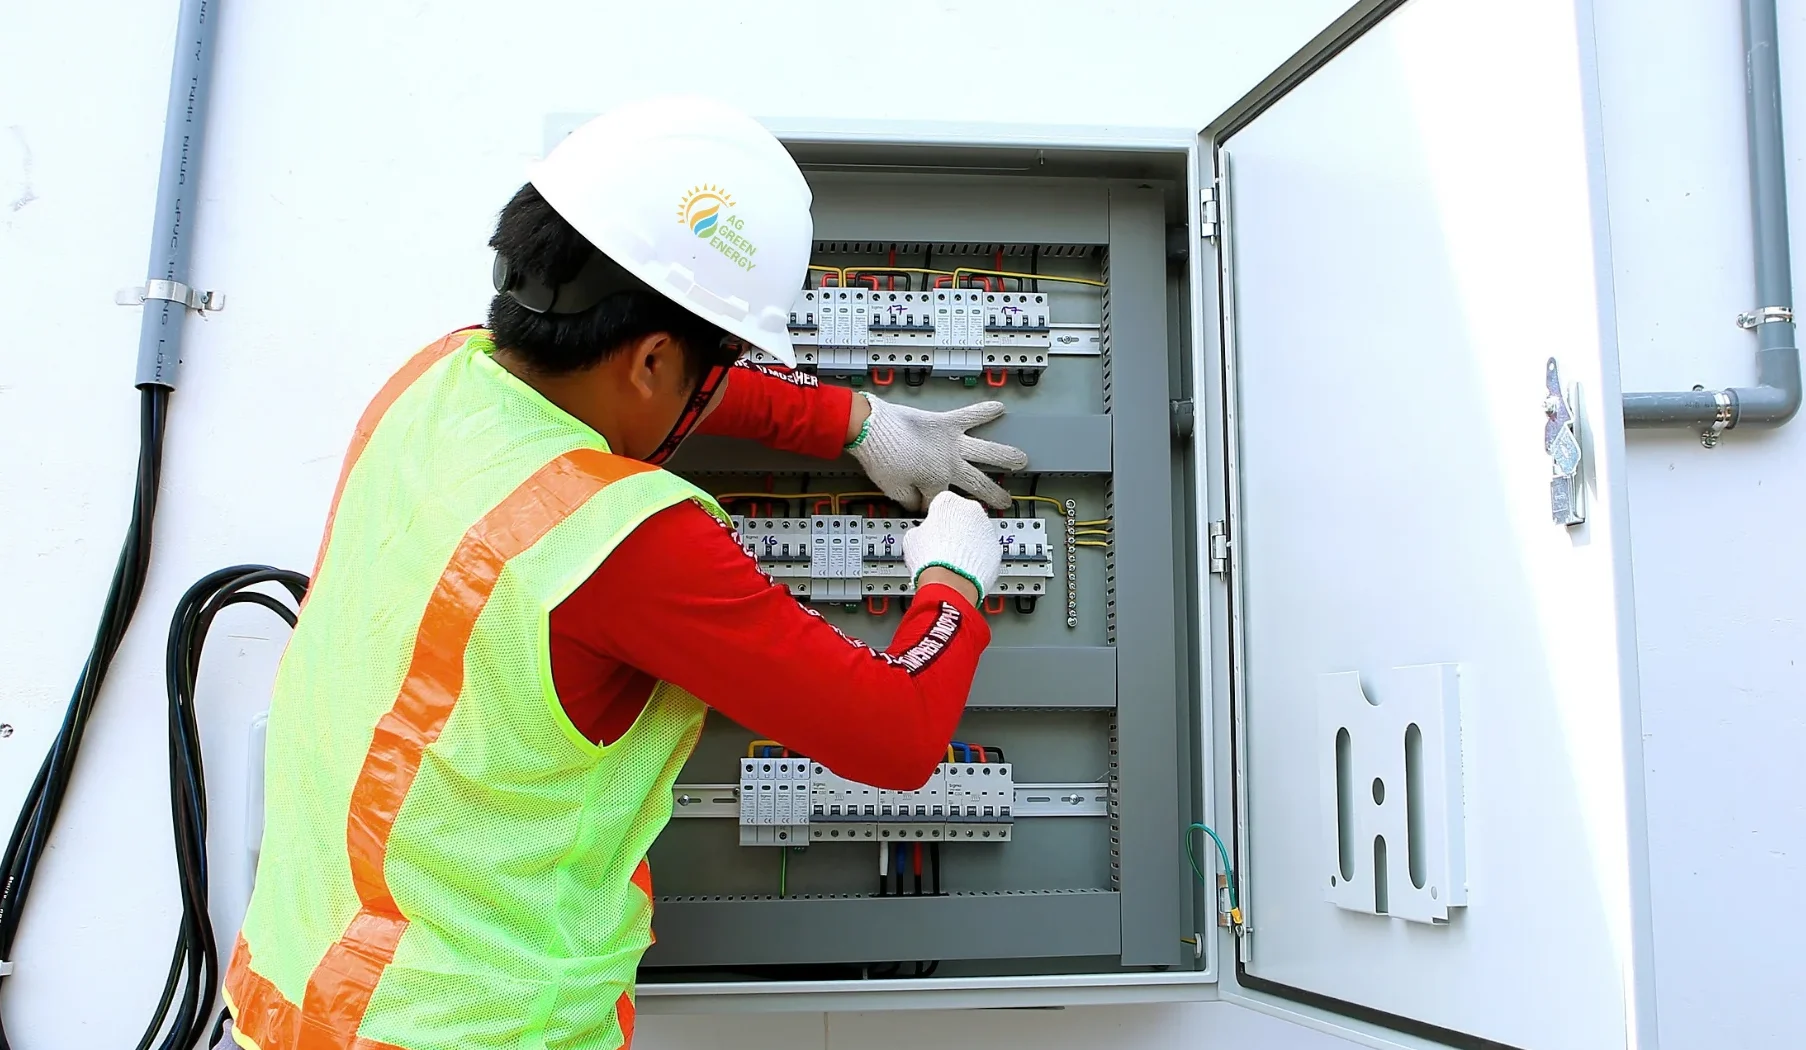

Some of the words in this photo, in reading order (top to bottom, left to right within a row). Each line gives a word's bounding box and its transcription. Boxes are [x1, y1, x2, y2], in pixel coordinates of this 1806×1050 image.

[179, 135, 190, 186] NHUA
[726, 214, 745, 231] AG
[718, 225, 757, 256] GREEN
[709, 235, 756, 272] ENERGY
[161, 261, 176, 326] HONG
[886, 304, 909, 316] 17
[1001, 305, 1024, 316] 17
[761, 534, 778, 546] 16
[881, 533, 896, 546] 16
